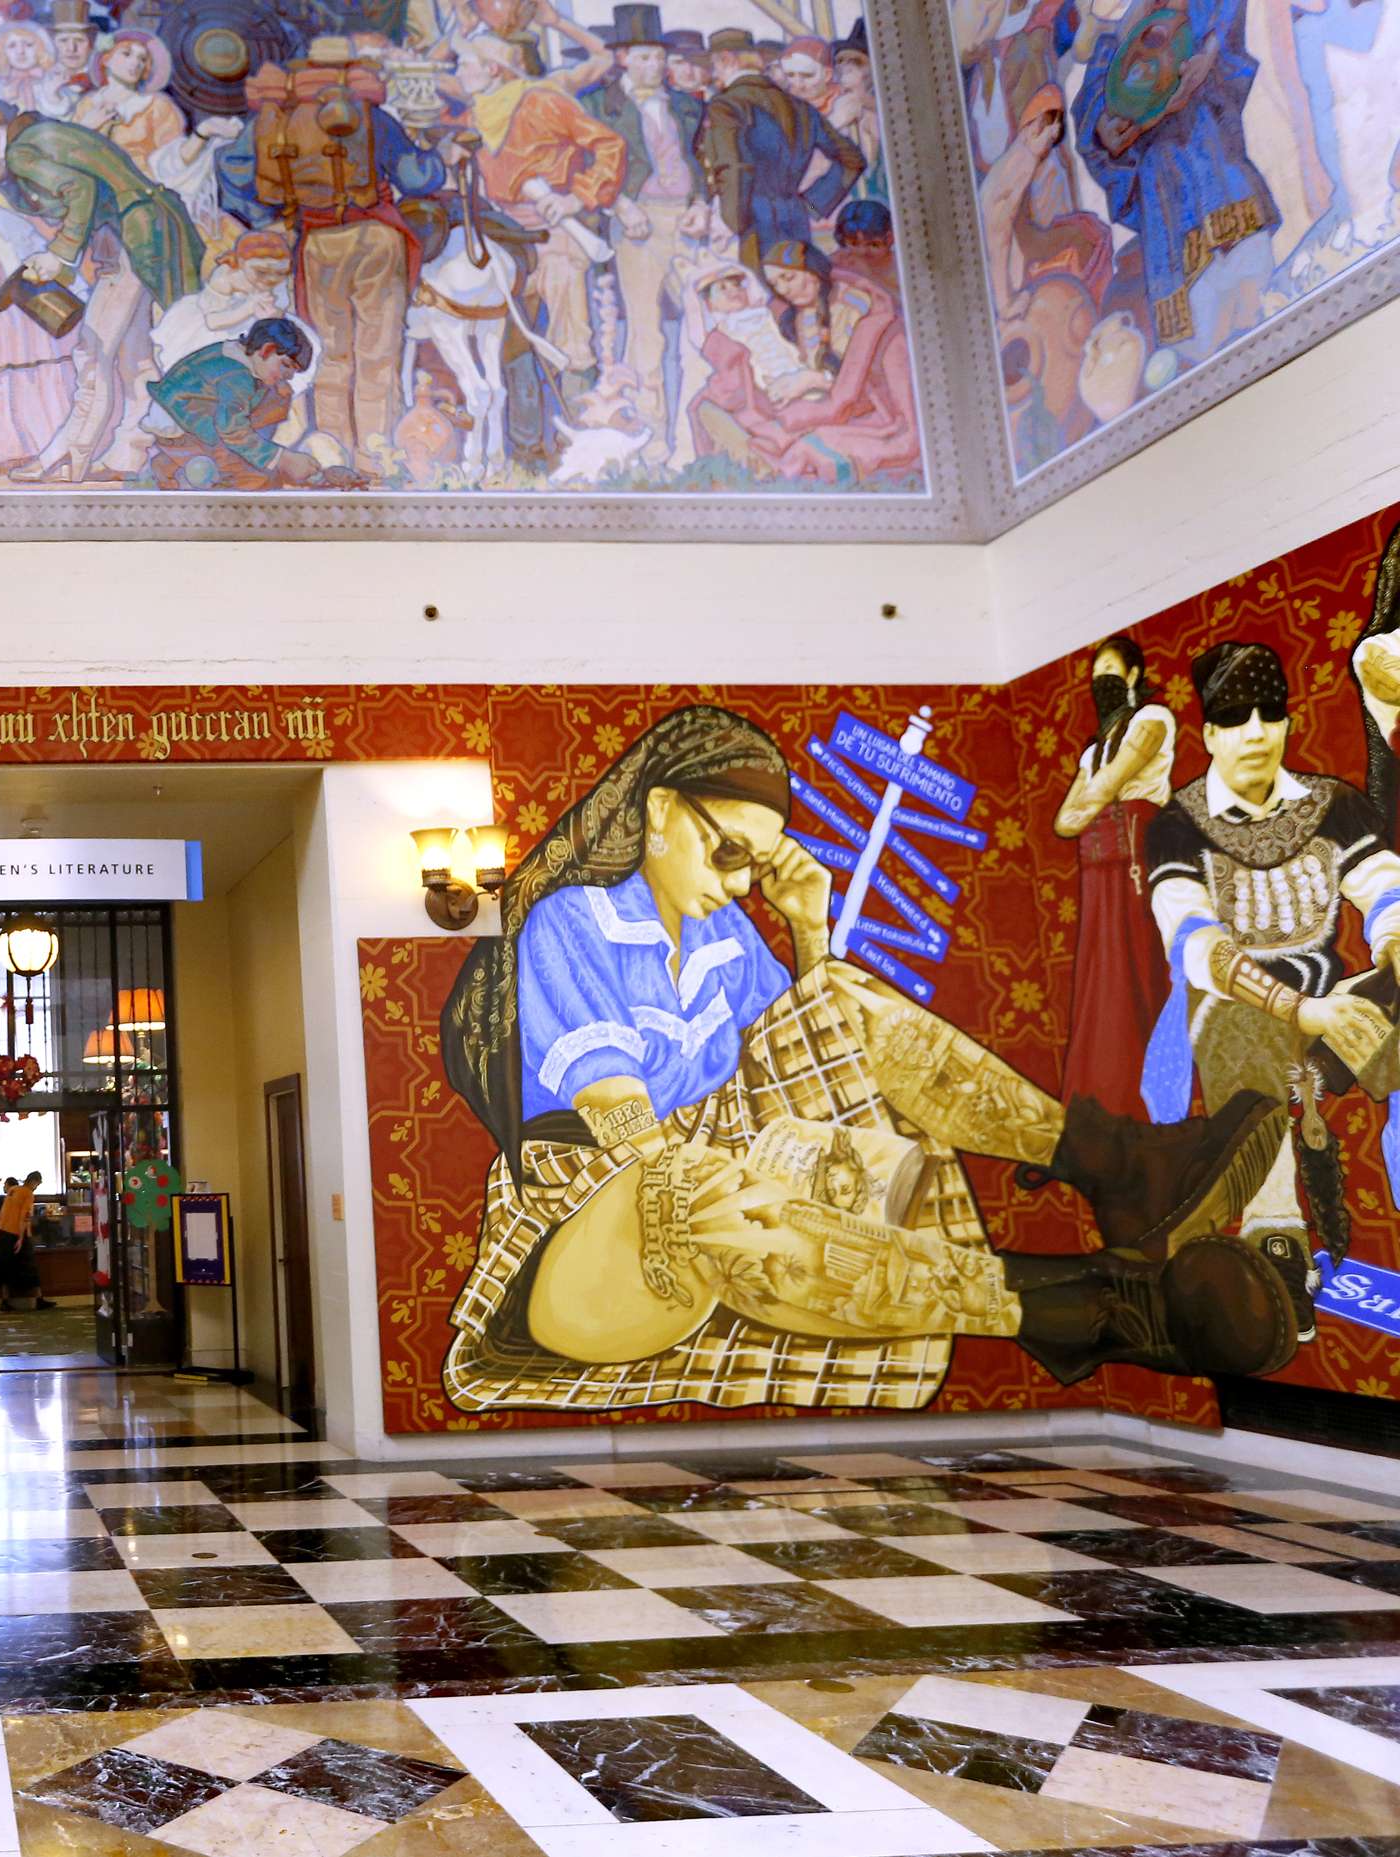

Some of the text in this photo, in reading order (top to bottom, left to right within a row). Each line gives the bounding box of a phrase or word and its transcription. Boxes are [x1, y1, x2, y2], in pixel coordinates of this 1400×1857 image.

[835, 730, 963, 811] DE TU SUFRIMIENTO
[49, 863, 154, 875] LITERATURE
